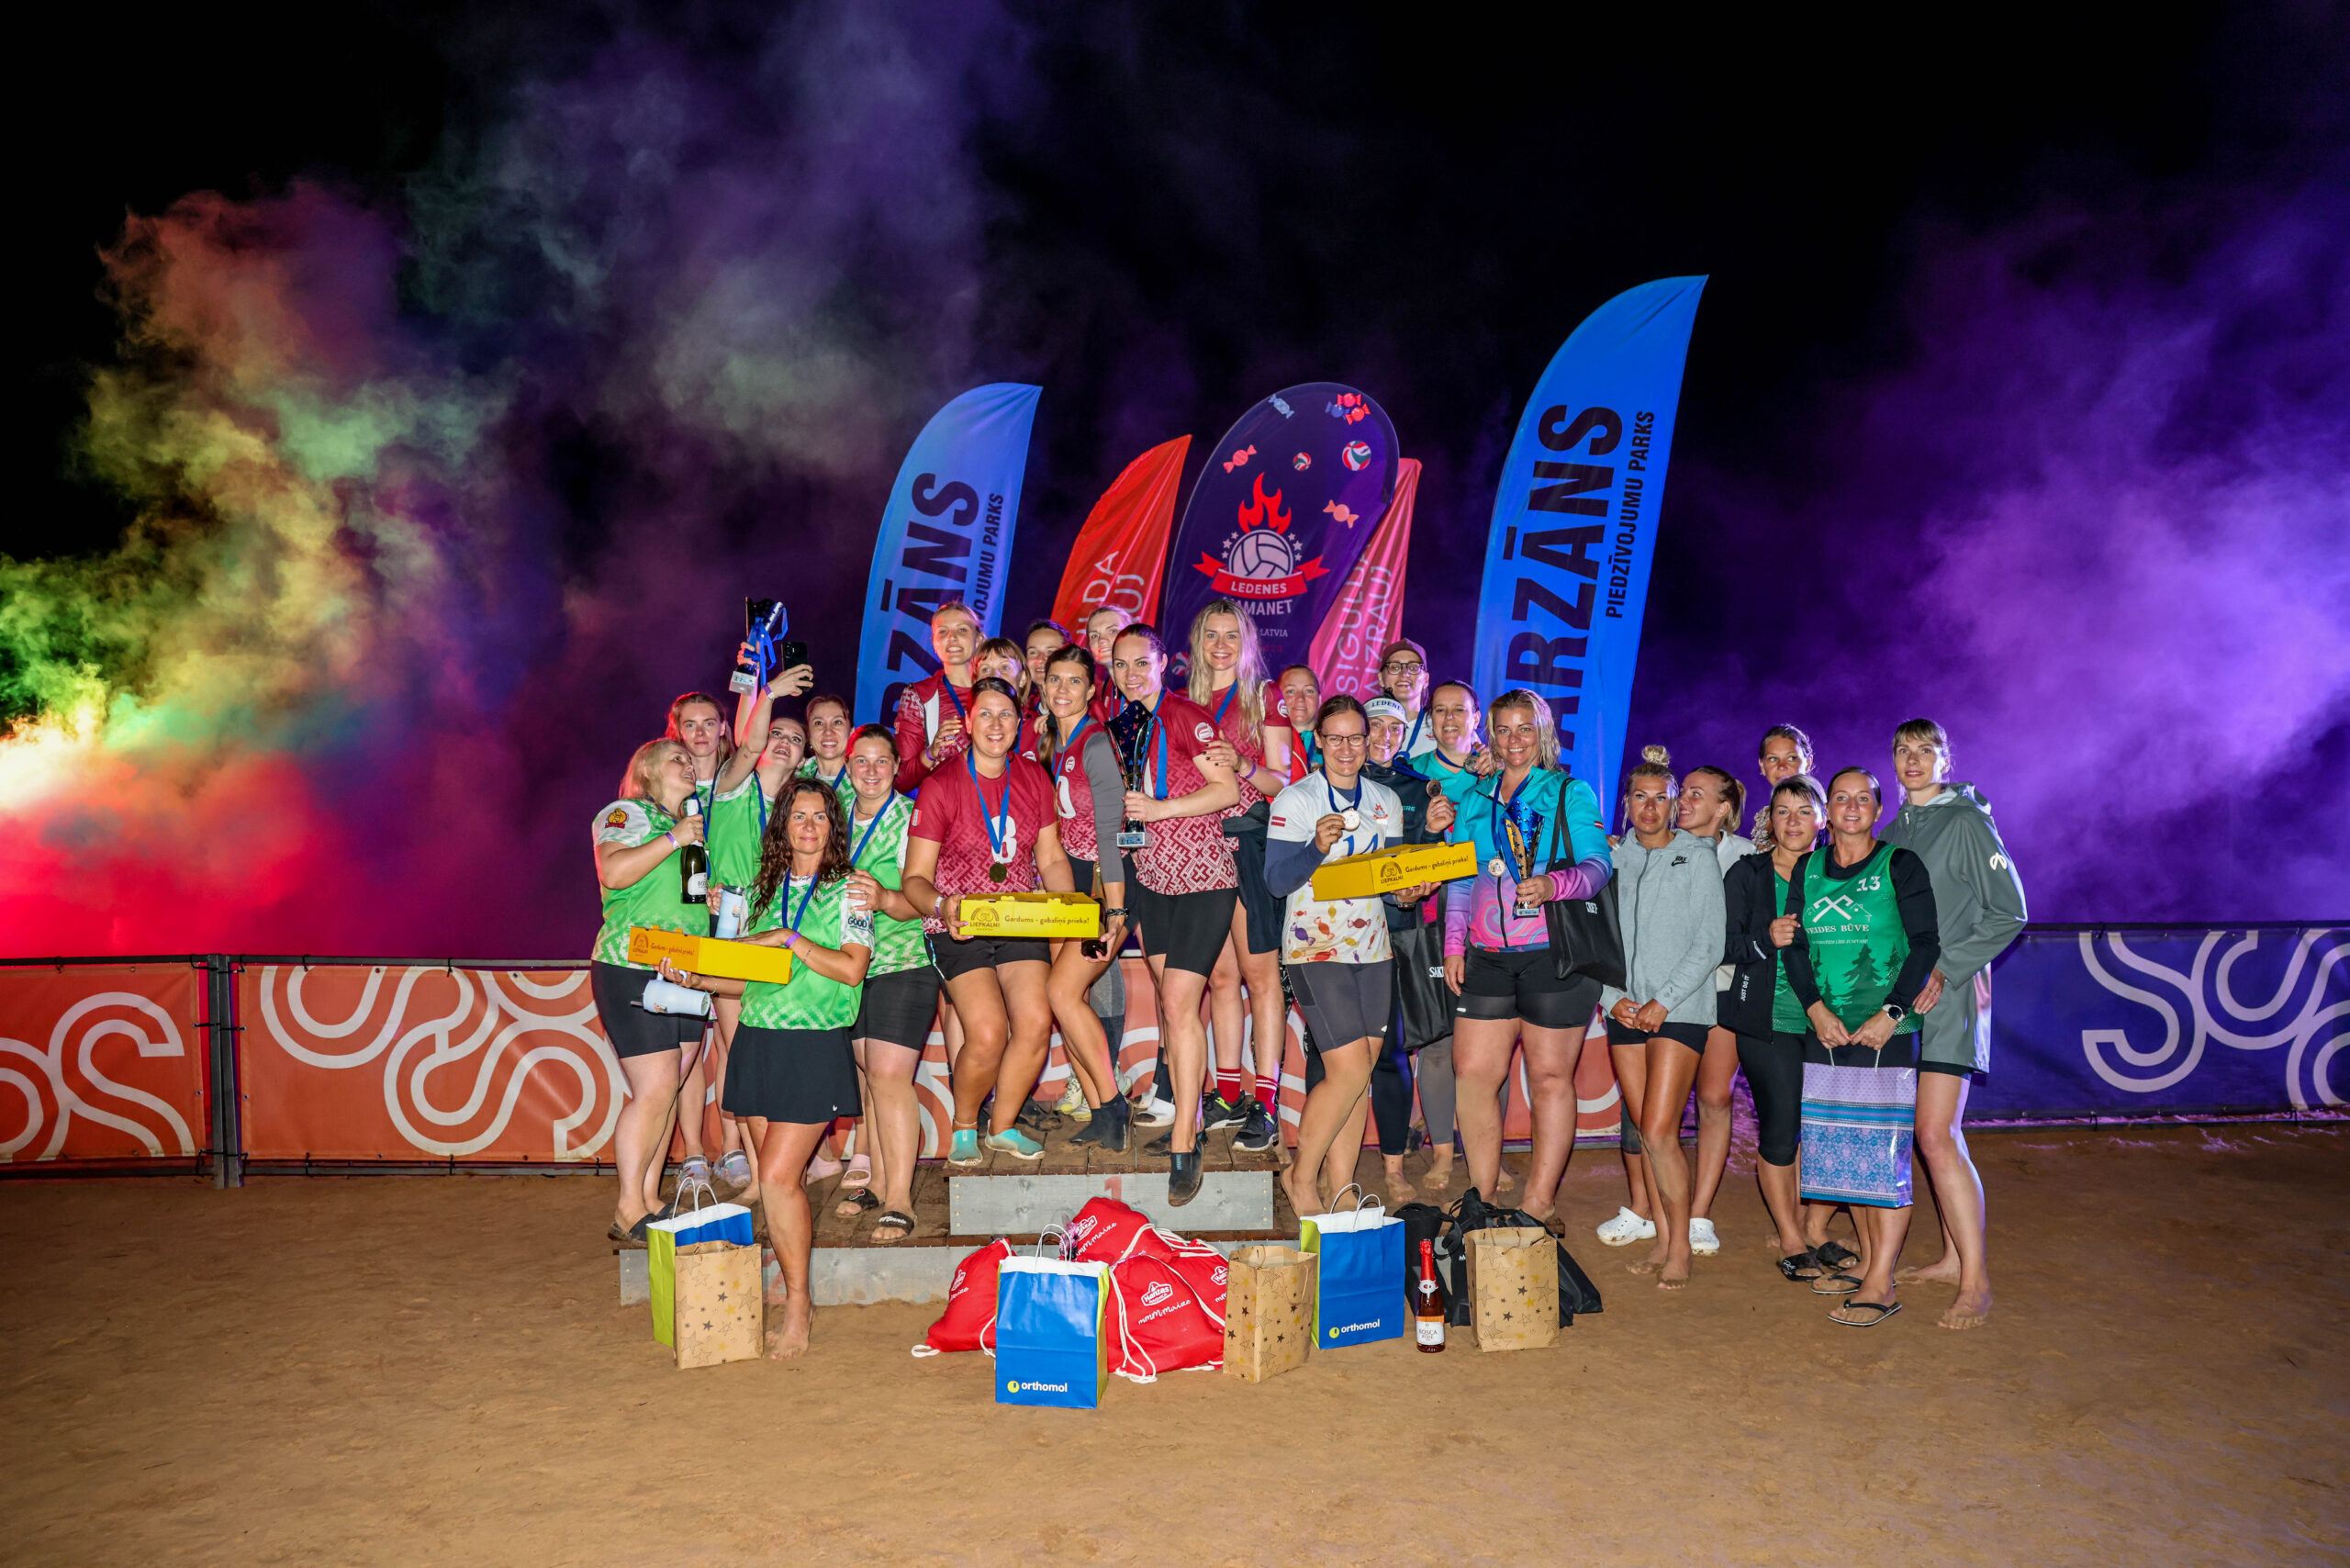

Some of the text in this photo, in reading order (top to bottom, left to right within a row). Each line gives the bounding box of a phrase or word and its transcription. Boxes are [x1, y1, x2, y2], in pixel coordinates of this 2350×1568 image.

[983, 492, 1004, 546] PARKS
[1606, 410, 1655, 619] PIEDZĪVOJUMU PARKS
[1230, 581, 1288, 595] LEDENES
[1260, 628, 1288, 637] LATVIA
[1405, 865, 1428, 873] Gardums
[1452, 856, 1469, 866] prieka!
[1856, 875, 1882, 891] 13
[847, 916, 867, 928] GOOD
[1004, 914, 1034, 924] Gardums
[1067, 917, 1090, 925] prieka!
[1104, 1176, 1122, 1200] 1
[1144, 1286, 1169, 1303] Hanzas
[1341, 1318, 1380, 1333] orthomol
[1021, 1381, 1068, 1393] orthomol
